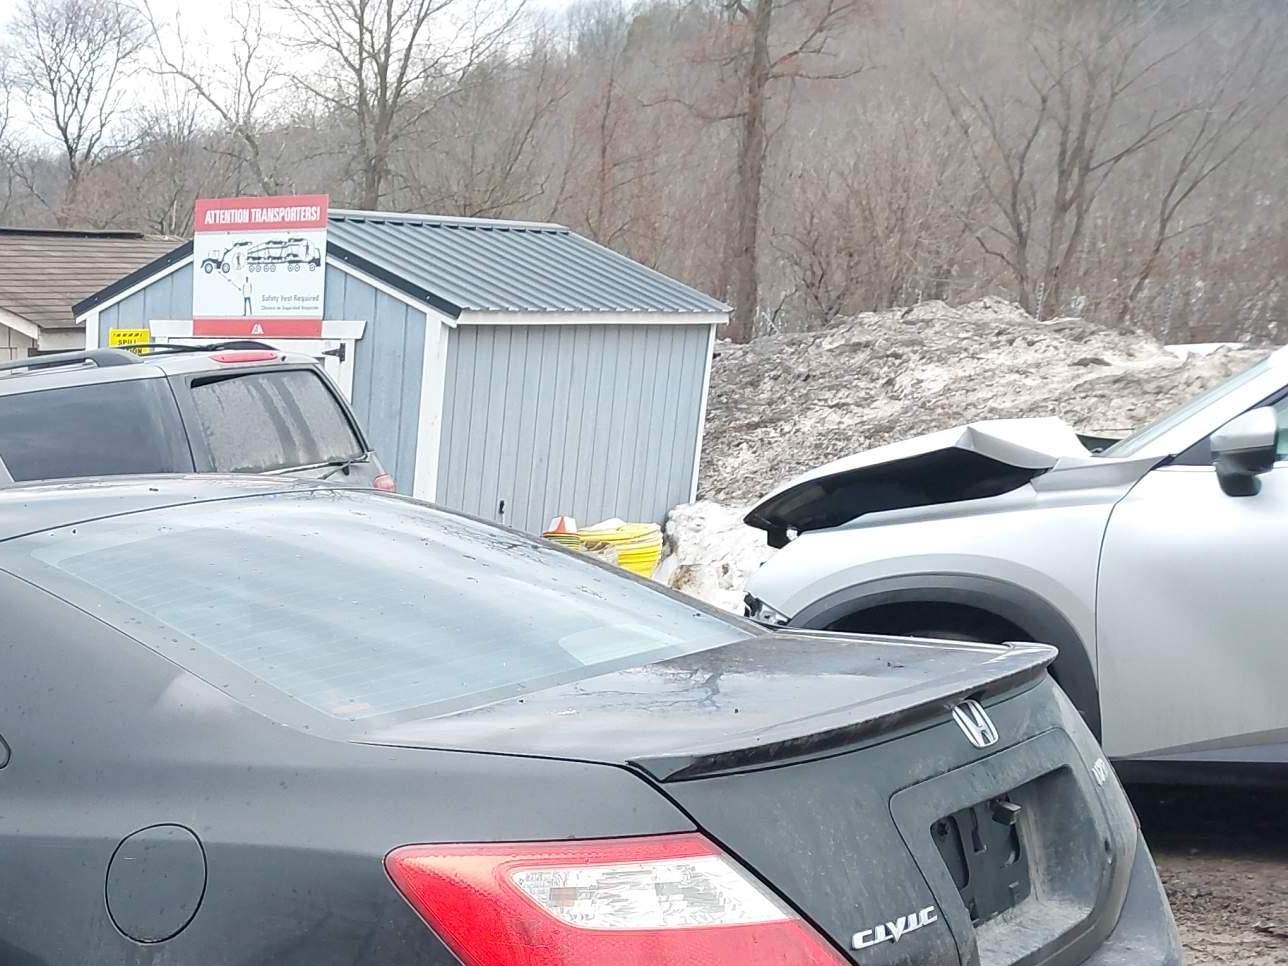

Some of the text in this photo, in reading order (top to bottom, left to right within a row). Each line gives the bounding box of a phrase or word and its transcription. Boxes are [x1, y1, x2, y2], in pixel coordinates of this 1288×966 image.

[204, 205, 321, 225] ATTENTION TRANSPORTERS!
[852, 905, 938, 950] CIVIC
